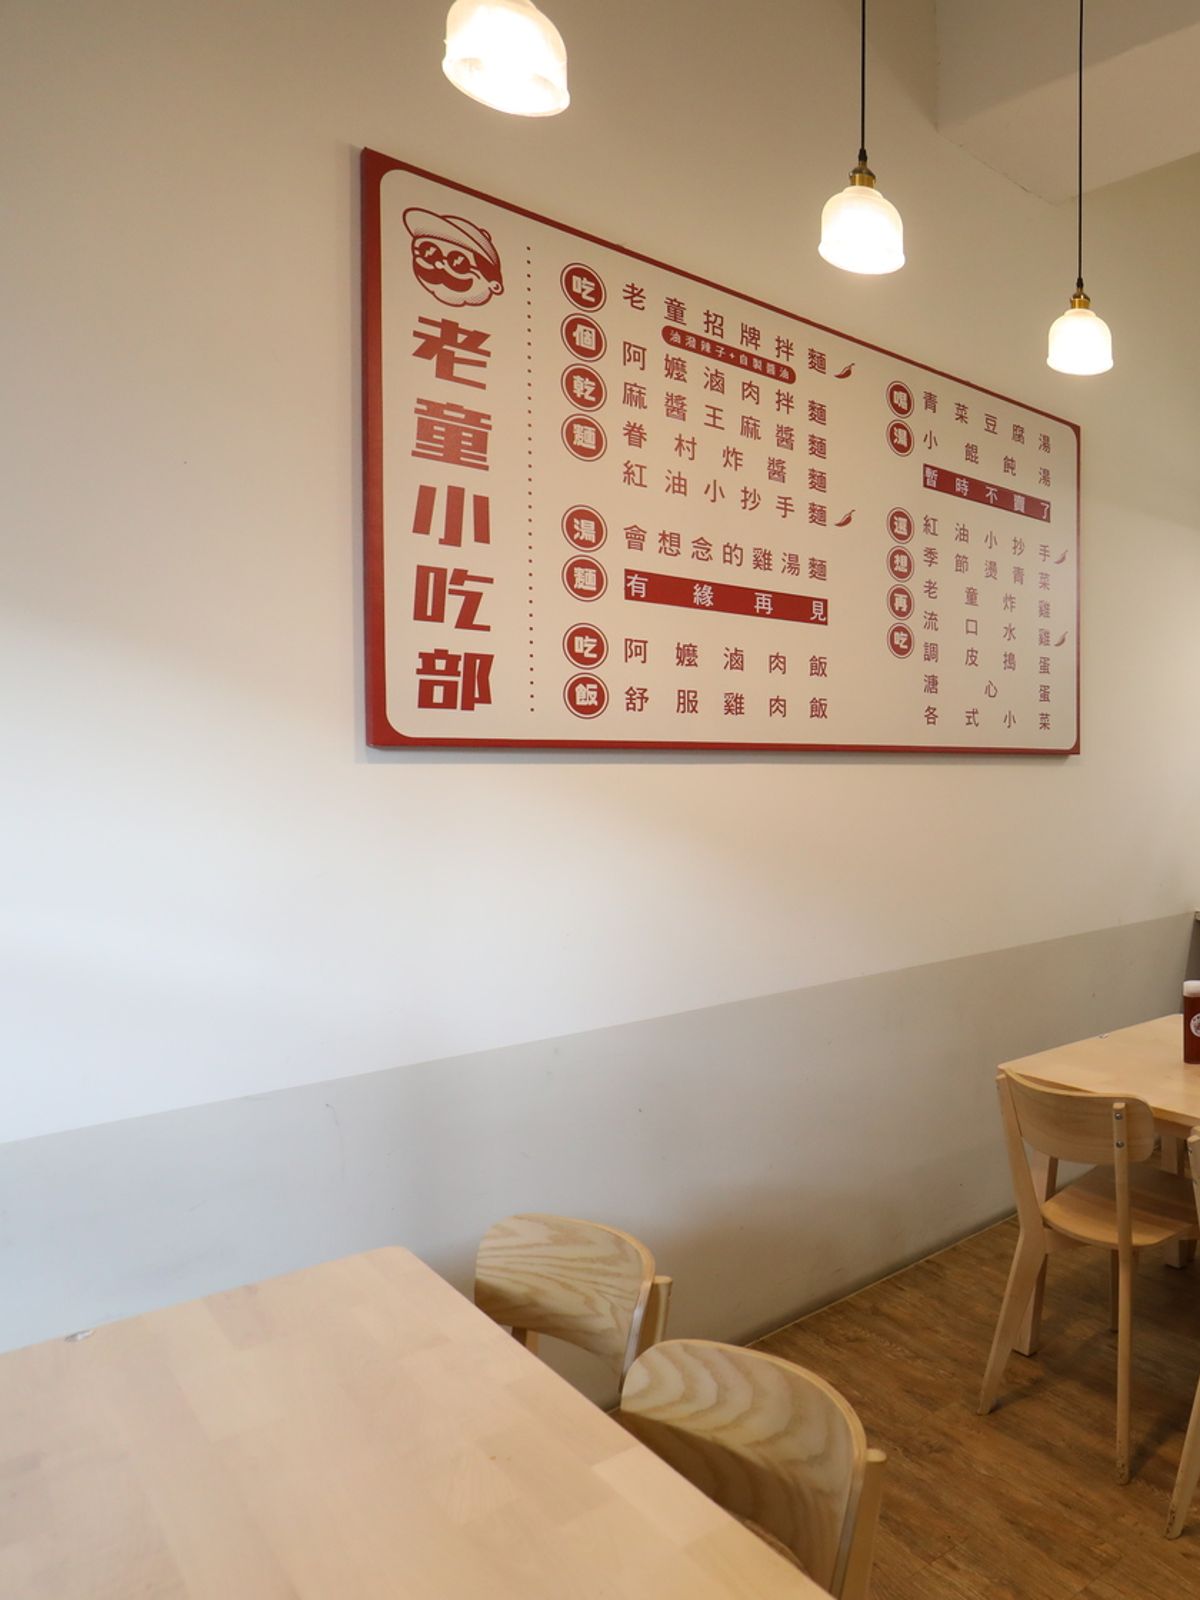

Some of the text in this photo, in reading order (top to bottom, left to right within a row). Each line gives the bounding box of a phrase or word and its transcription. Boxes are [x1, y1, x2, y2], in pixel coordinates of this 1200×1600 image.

[622, 282, 827, 376] 老童招牌拌麵
[622, 340, 827, 426] 阿嬤滷肉拌麵
[622, 382, 827, 460] 麻醬王麻醬麵
[922, 390, 1051, 454] 青菜豆腐湯
[622, 420, 827, 493] 眷村炸醬麵
[922, 430, 1051, 487] 小餛飩湯
[411, 316, 495, 711] 老童小吃部
[622, 460, 827, 527] 紅油小抄手麵
[623, 523, 828, 581] 會想念的雞湯麵
[922, 514, 1051, 563] 紅油小抄手
[922, 546, 1051, 591] 季節燙青菜
[625, 573, 828, 623] 有緣再見
[922, 579, 1051, 619] 老童炸雞
[922, 610, 1051, 648] 流口水雞
[623, 638, 828, 678] 阿嬤滷肉飯
[922, 641, 1051, 676] 調皮搗蛋
[624, 685, 828, 720] 舒服雞肉飯
[922, 673, 1051, 703] 溏心蛋
[923, 705, 1051, 731] 各式小菜
